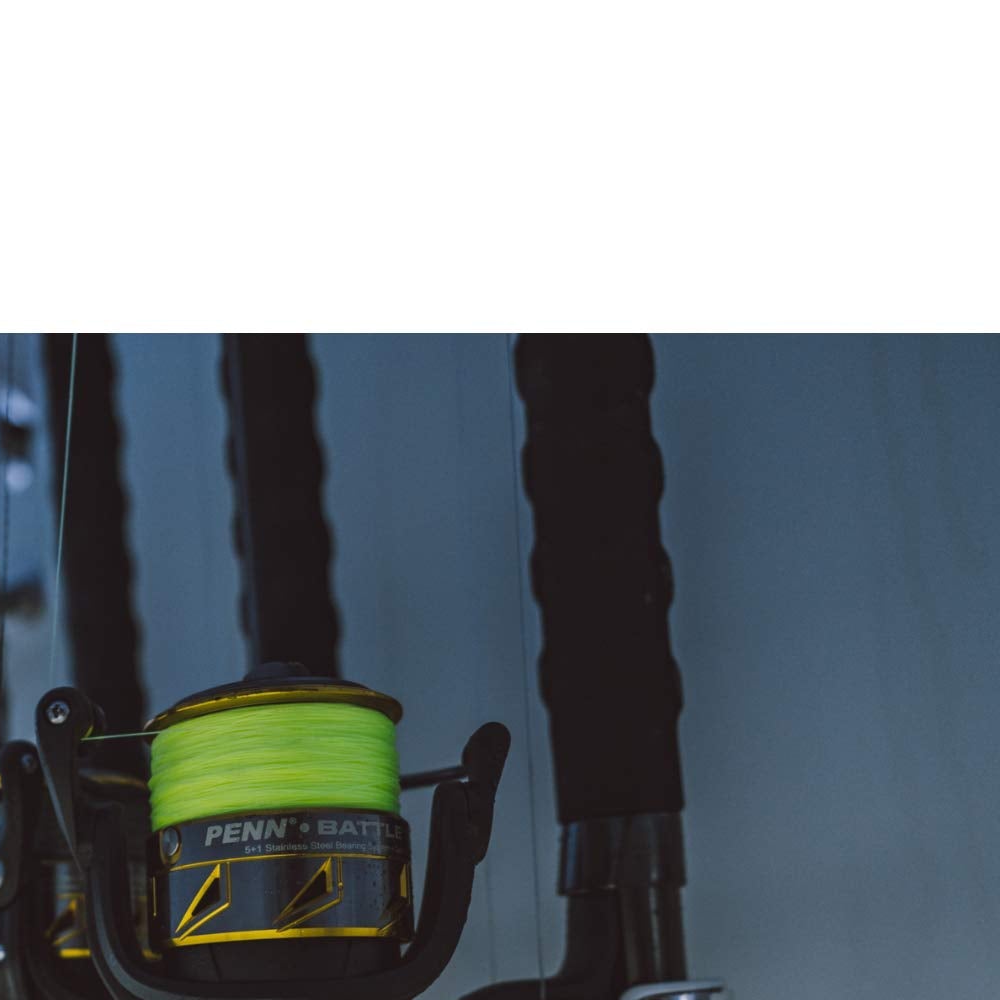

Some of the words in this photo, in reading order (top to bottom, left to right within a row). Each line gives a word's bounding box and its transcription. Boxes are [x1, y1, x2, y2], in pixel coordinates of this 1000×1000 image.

[244, 845, 262, 854] 5+1
[265, 842, 309, 853] Stainless
[310, 841, 334, 850] Steel
